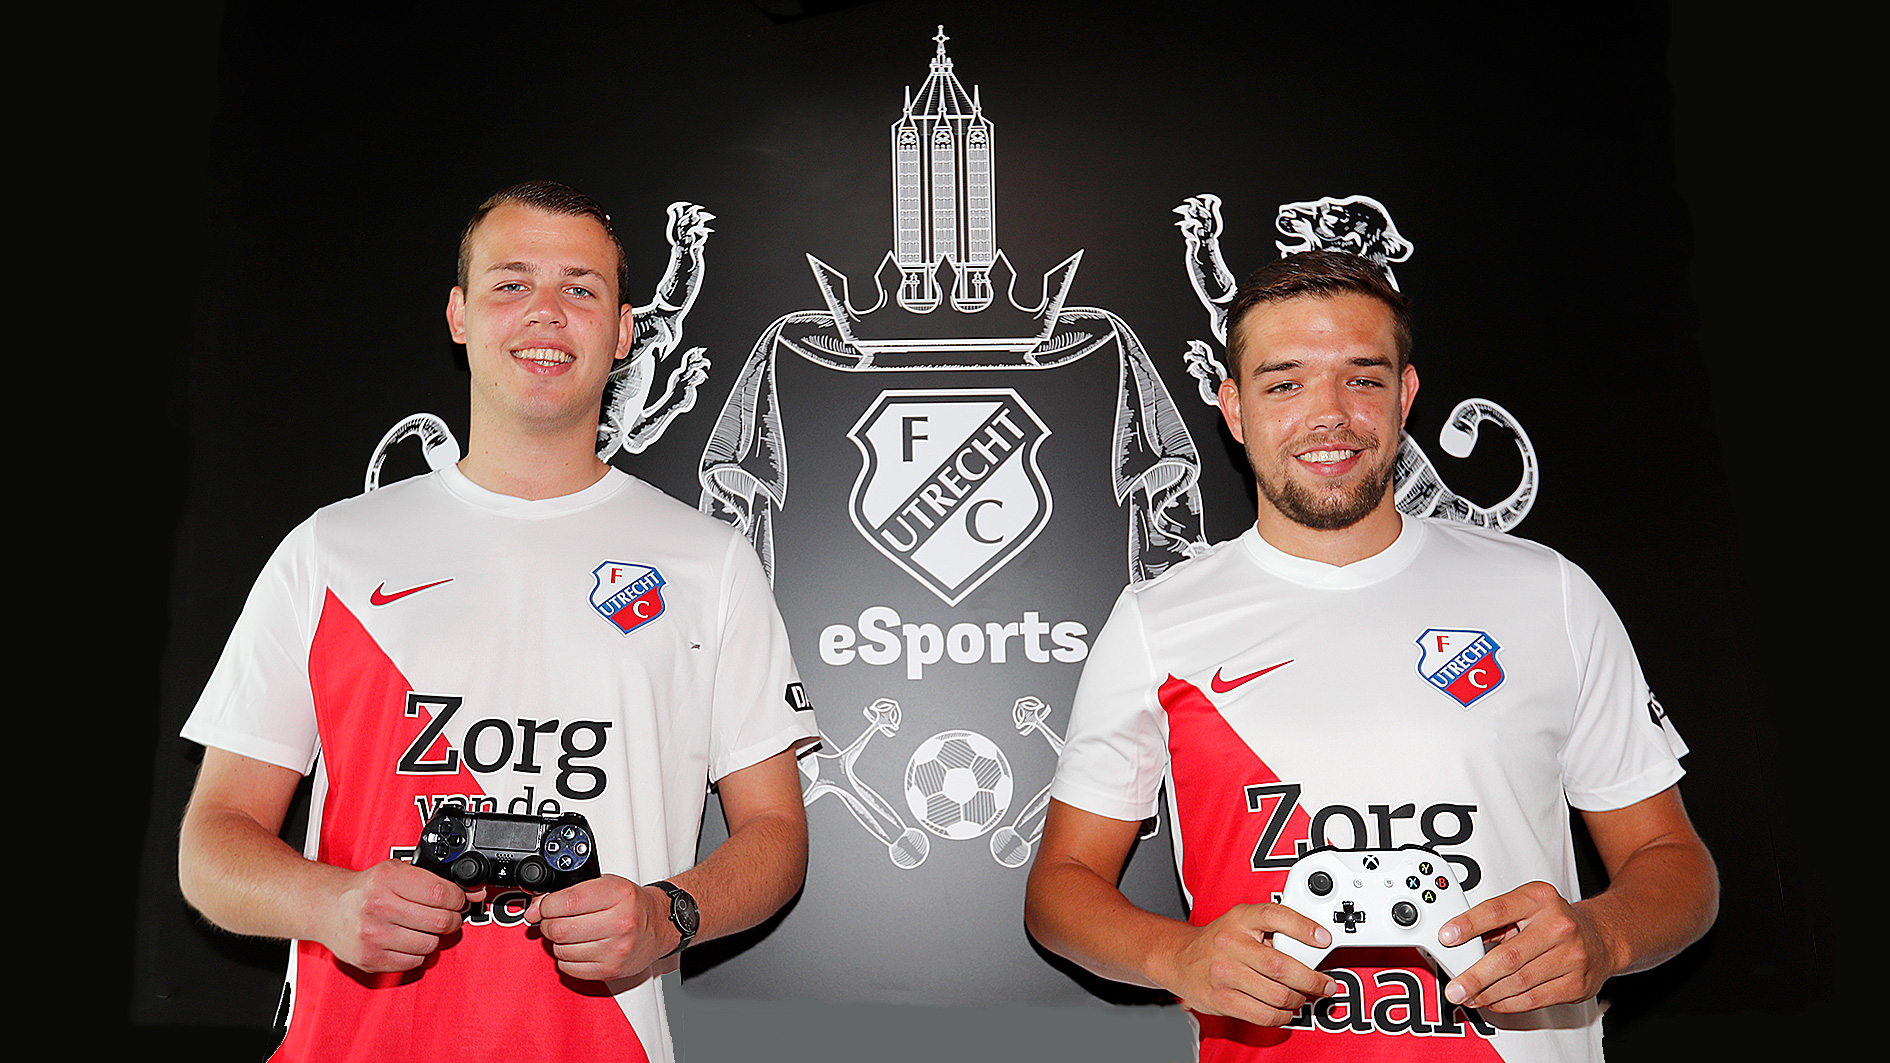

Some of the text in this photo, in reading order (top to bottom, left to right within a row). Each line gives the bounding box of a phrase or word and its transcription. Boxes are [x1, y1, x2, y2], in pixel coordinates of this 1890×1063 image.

[902, 416, 928, 463] F
[881, 409, 1025, 551] UTRECHT
[965, 499, 1005, 544] C
[599, 572, 660, 616] UTRECHT
[611, 568, 623, 584] F
[633, 601, 650, 619] C
[819, 606, 1089, 680] eSports
[1430, 636, 1493, 688] UTRECHT
[1436, 635, 1450, 653] F
[1468, 669, 1488, 689] C
[398, 694, 613, 801] Zorg
[1246, 783, 1482, 892] Zorg
[1409, 877, 1418, 888] X
[1421, 863, 1430, 874] Y
[1438, 877, 1447, 888] B
[1424, 890, 1434, 902] A
[1282, 964, 1497, 1036] aak
